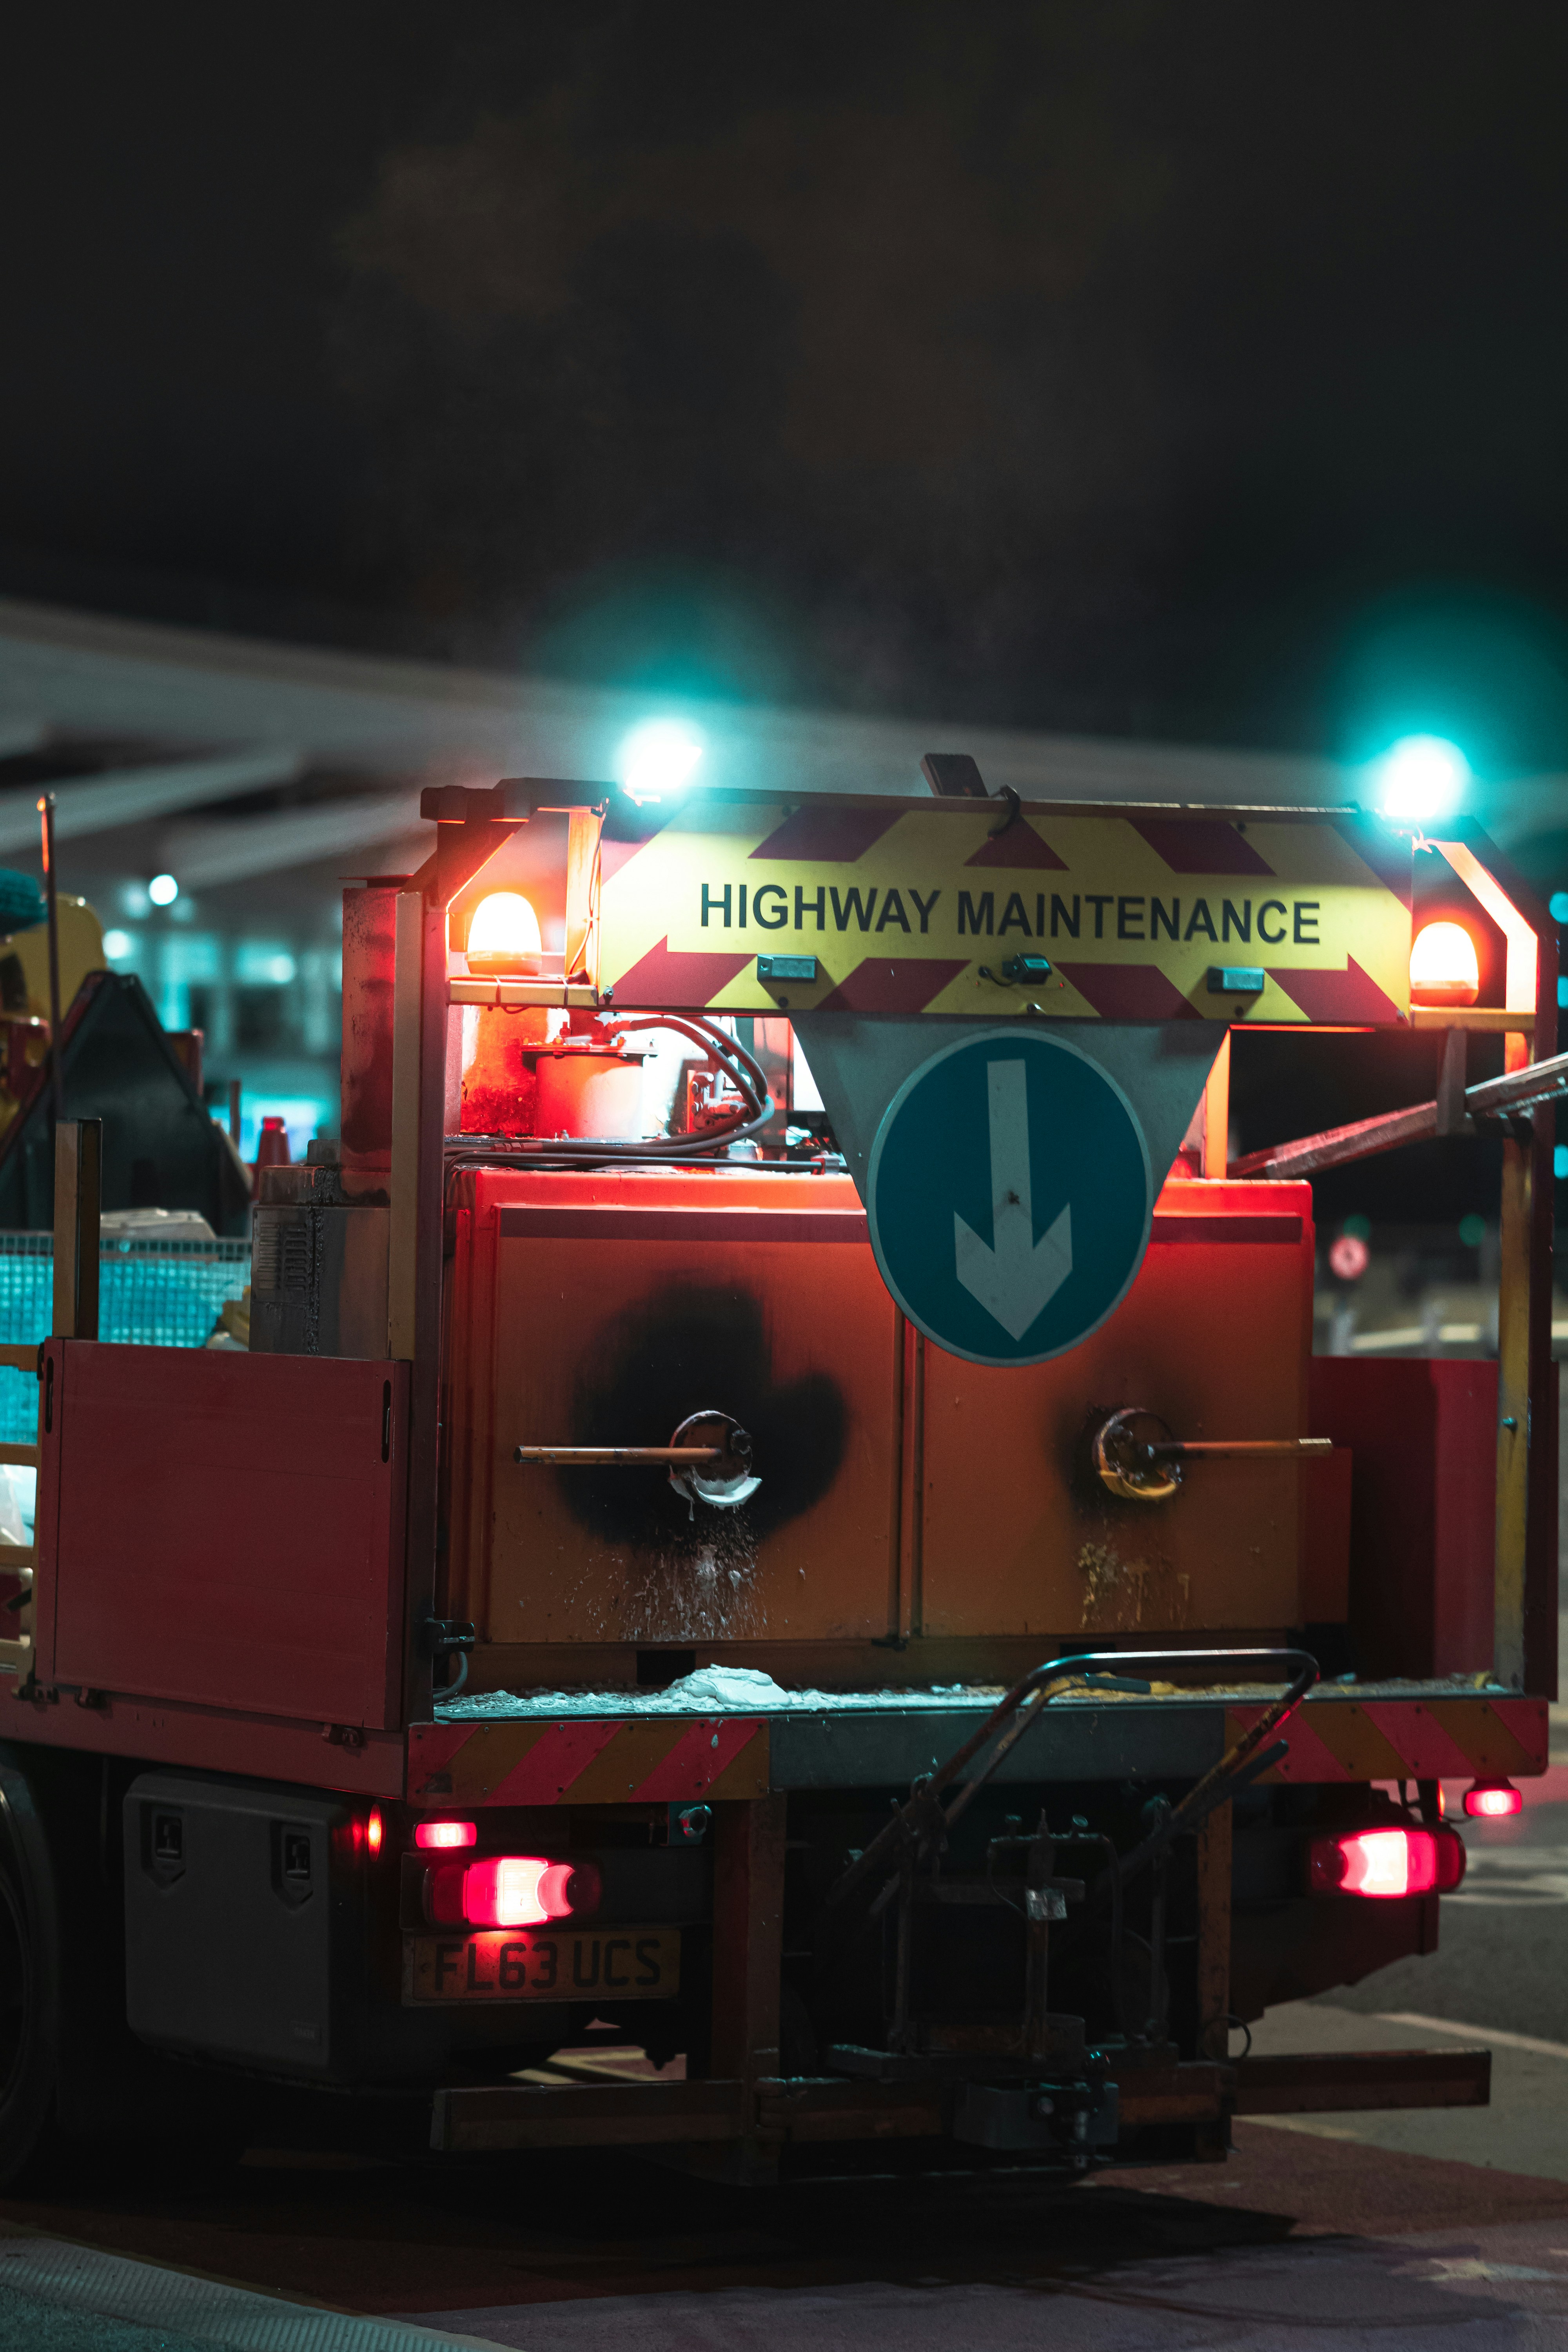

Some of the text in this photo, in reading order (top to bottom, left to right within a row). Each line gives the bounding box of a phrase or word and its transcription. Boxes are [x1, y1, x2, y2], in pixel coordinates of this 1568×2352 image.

[701, 883, 1321, 944] HIGHWAY MAINTENANCE
[435, 1939, 661, 1991] FL63 UCS
